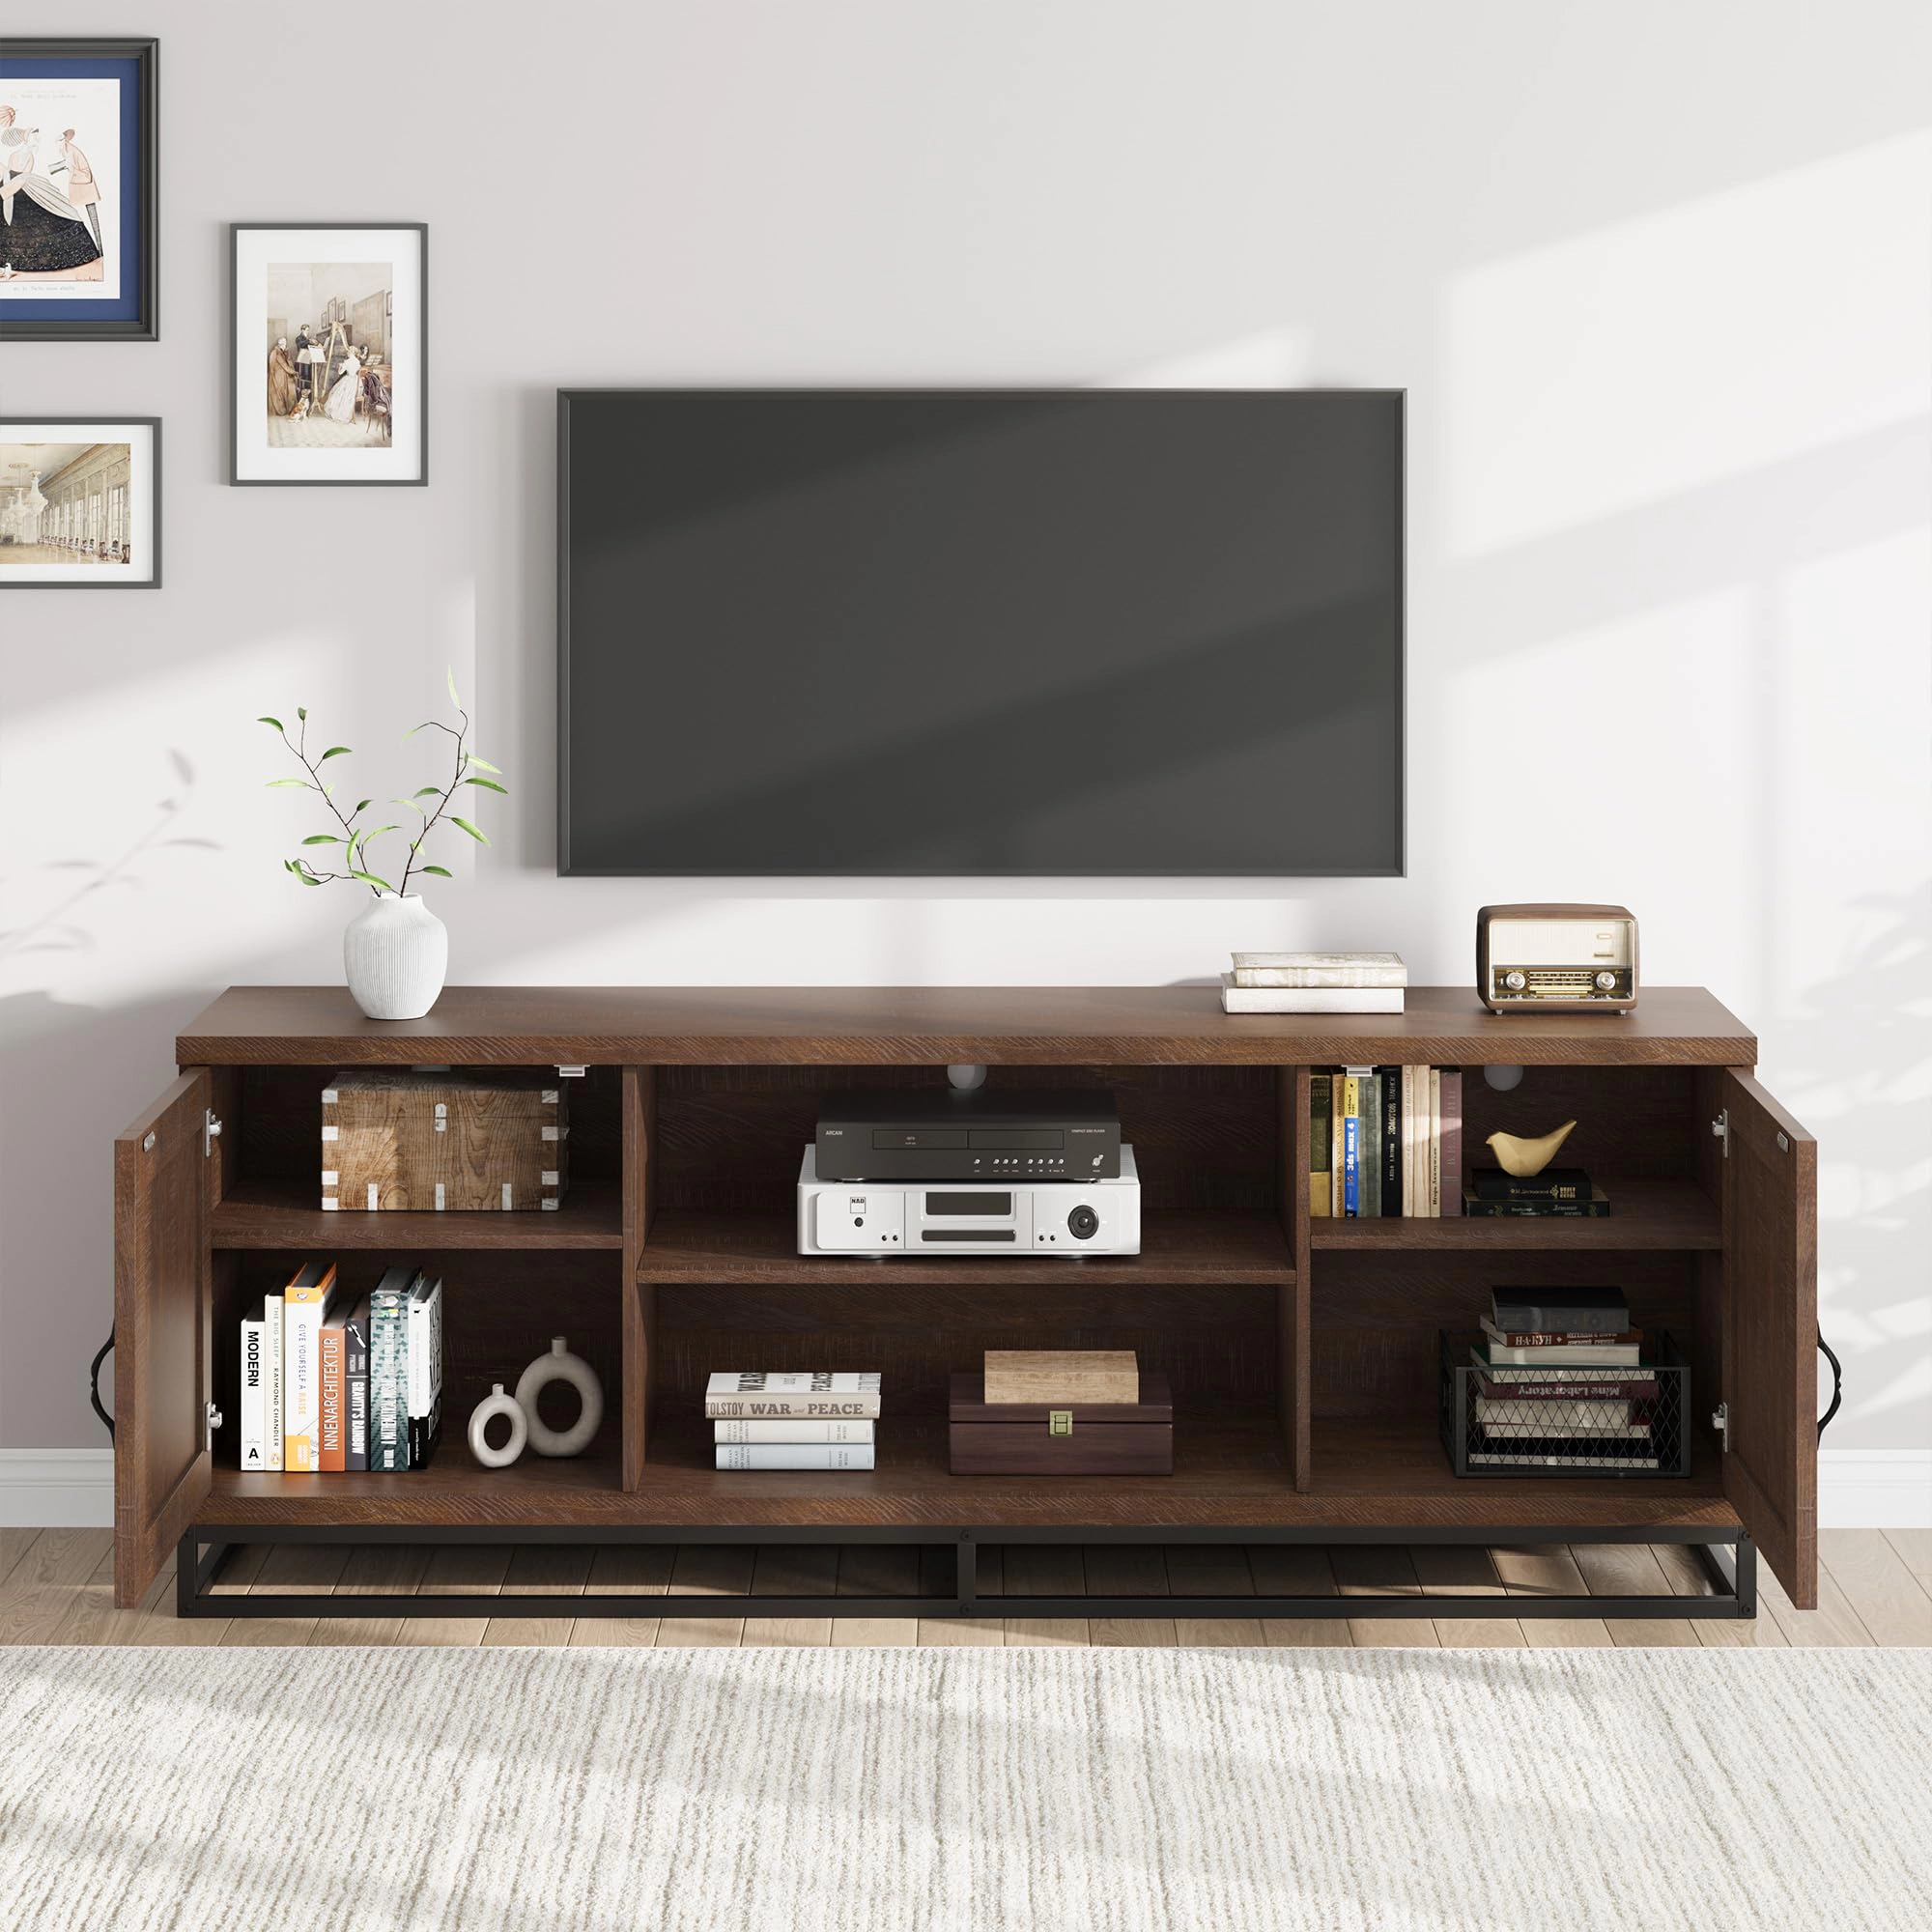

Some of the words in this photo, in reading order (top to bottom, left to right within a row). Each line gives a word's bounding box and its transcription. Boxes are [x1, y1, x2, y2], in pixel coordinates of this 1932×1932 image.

[248, 1331, 259, 1387] MODERN
[323, 1338, 338, 1451] INNENARCHITEKTUR
[352, 1382, 365, 1419] GRAVITY'S
[1518, 1385, 1588, 1397] Laboratory
[706, 1402, 744, 1415] TOLSTOY
[749, 1403, 791, 1415] WAR
[808, 1403, 864, 1415] PEACE
[248, 1447, 259, 1459] A
[352, 1420, 365, 1454] RAINBOW
